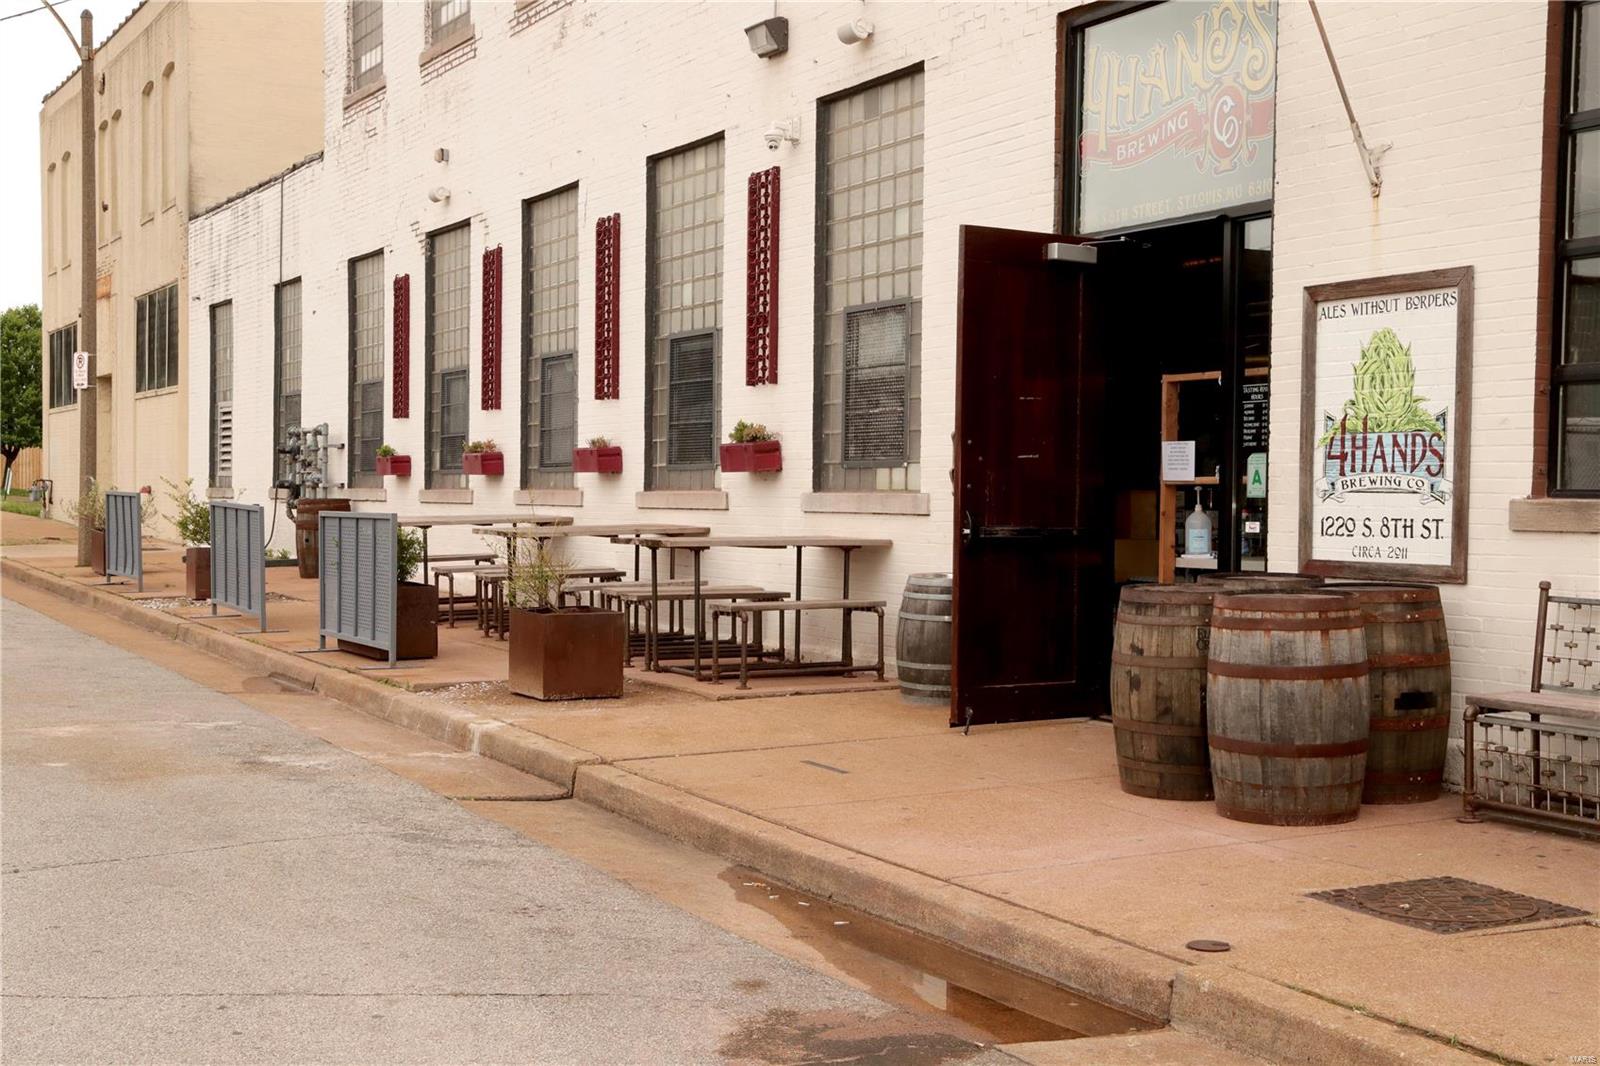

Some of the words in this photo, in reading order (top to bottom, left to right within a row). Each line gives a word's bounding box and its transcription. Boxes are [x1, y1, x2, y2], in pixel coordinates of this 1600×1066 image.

[1116, 111, 1189, 161] BREWING
[1320, 304, 1347, 321] ALES
[1351, 297, 1401, 316] WITHOUT
[1405, 290, 1458, 311] BORDERS
[1327, 413, 1445, 477] 4HANDS
[1251, 469, 1263, 486] A
[1341, 475, 1402, 491] BREWING
[1320, 515, 1356, 538] 1220
[1361, 516, 1375, 538] S.
[1379, 516, 1415, 539] 8TH
[1420, 517, 1445, 540] ST.
[1351, 544, 1382, 559] CIRCA
[1387, 545, 1409, 560] 2011
